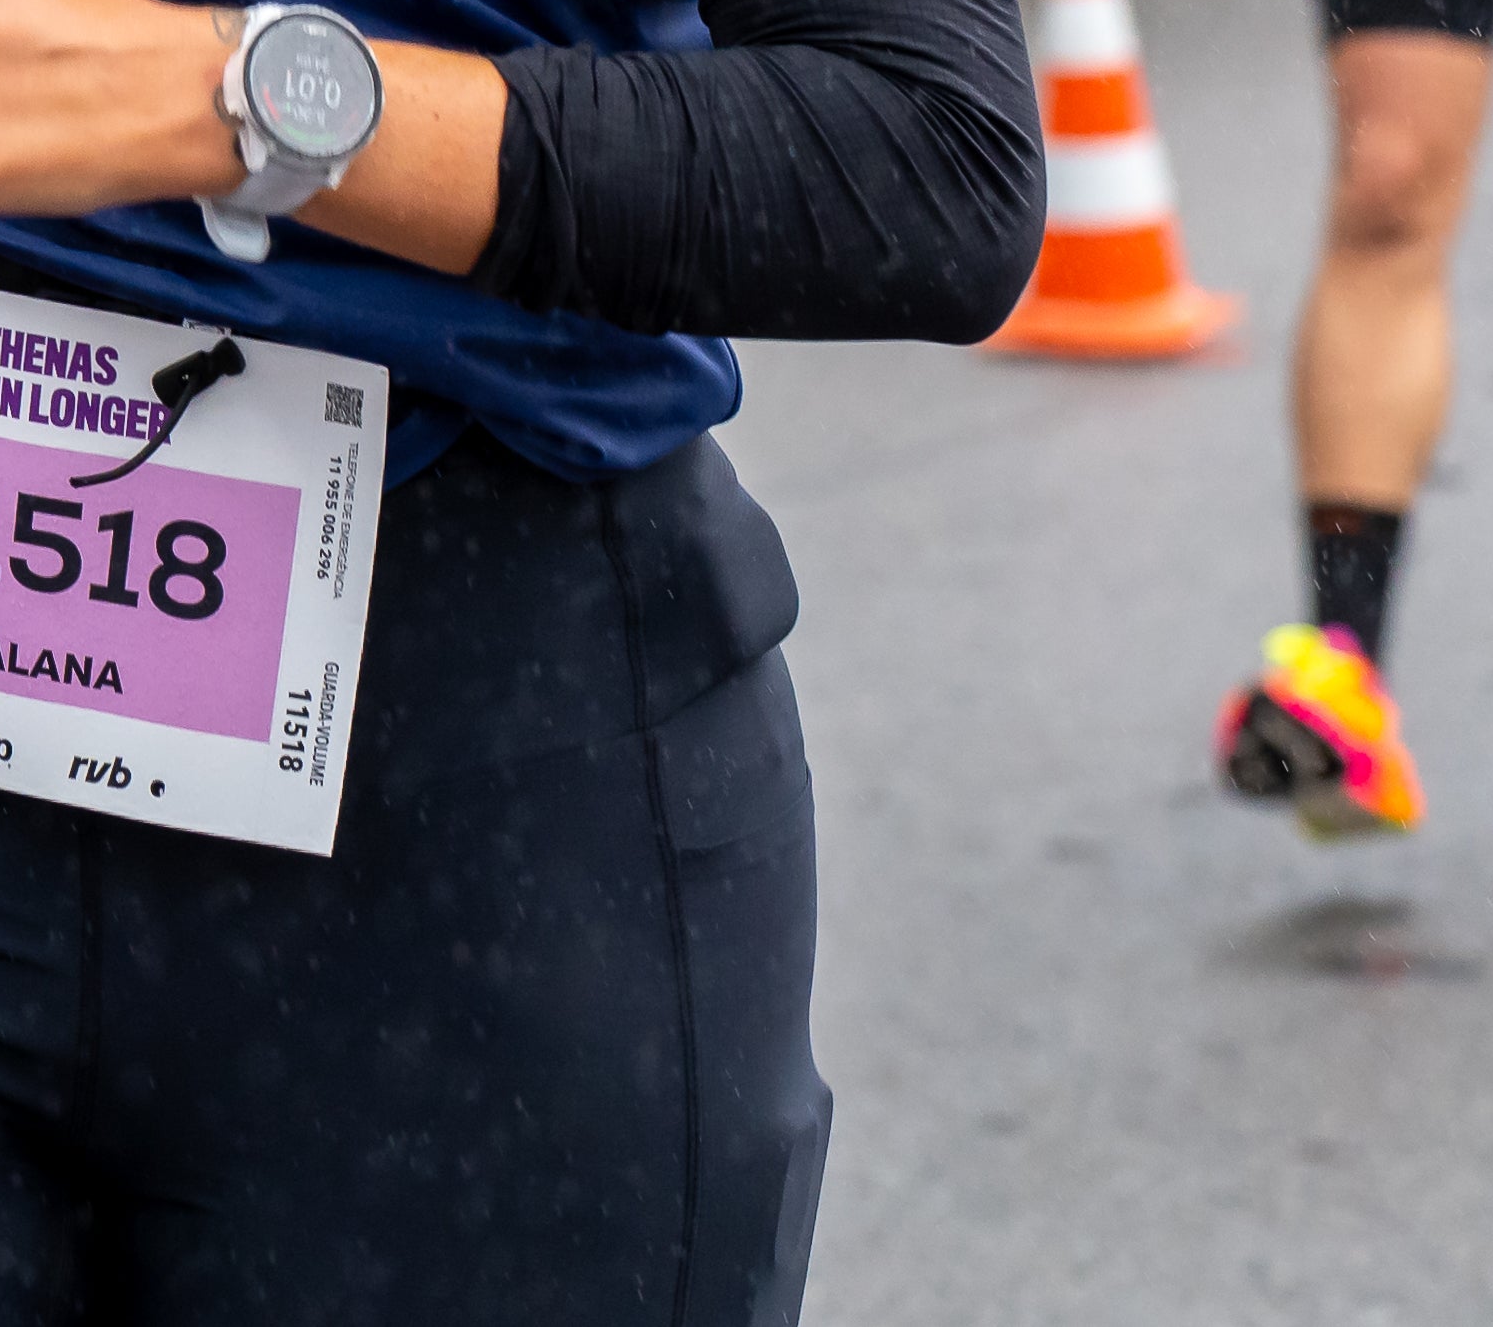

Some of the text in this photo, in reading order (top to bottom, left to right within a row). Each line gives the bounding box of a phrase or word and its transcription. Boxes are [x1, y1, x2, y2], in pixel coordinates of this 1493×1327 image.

[28, 383, 172, 447] LONGER
[343, 442, 359, 502] TELEFONE
[317, 456, 343, 580] 11 955 006 296
[341, 503, 353, 521] DE
[279, 689, 313, 773] 11518
[309, 661, 340, 787] GUARDA-VOLUME
[68, 754, 132, 790] rvb
